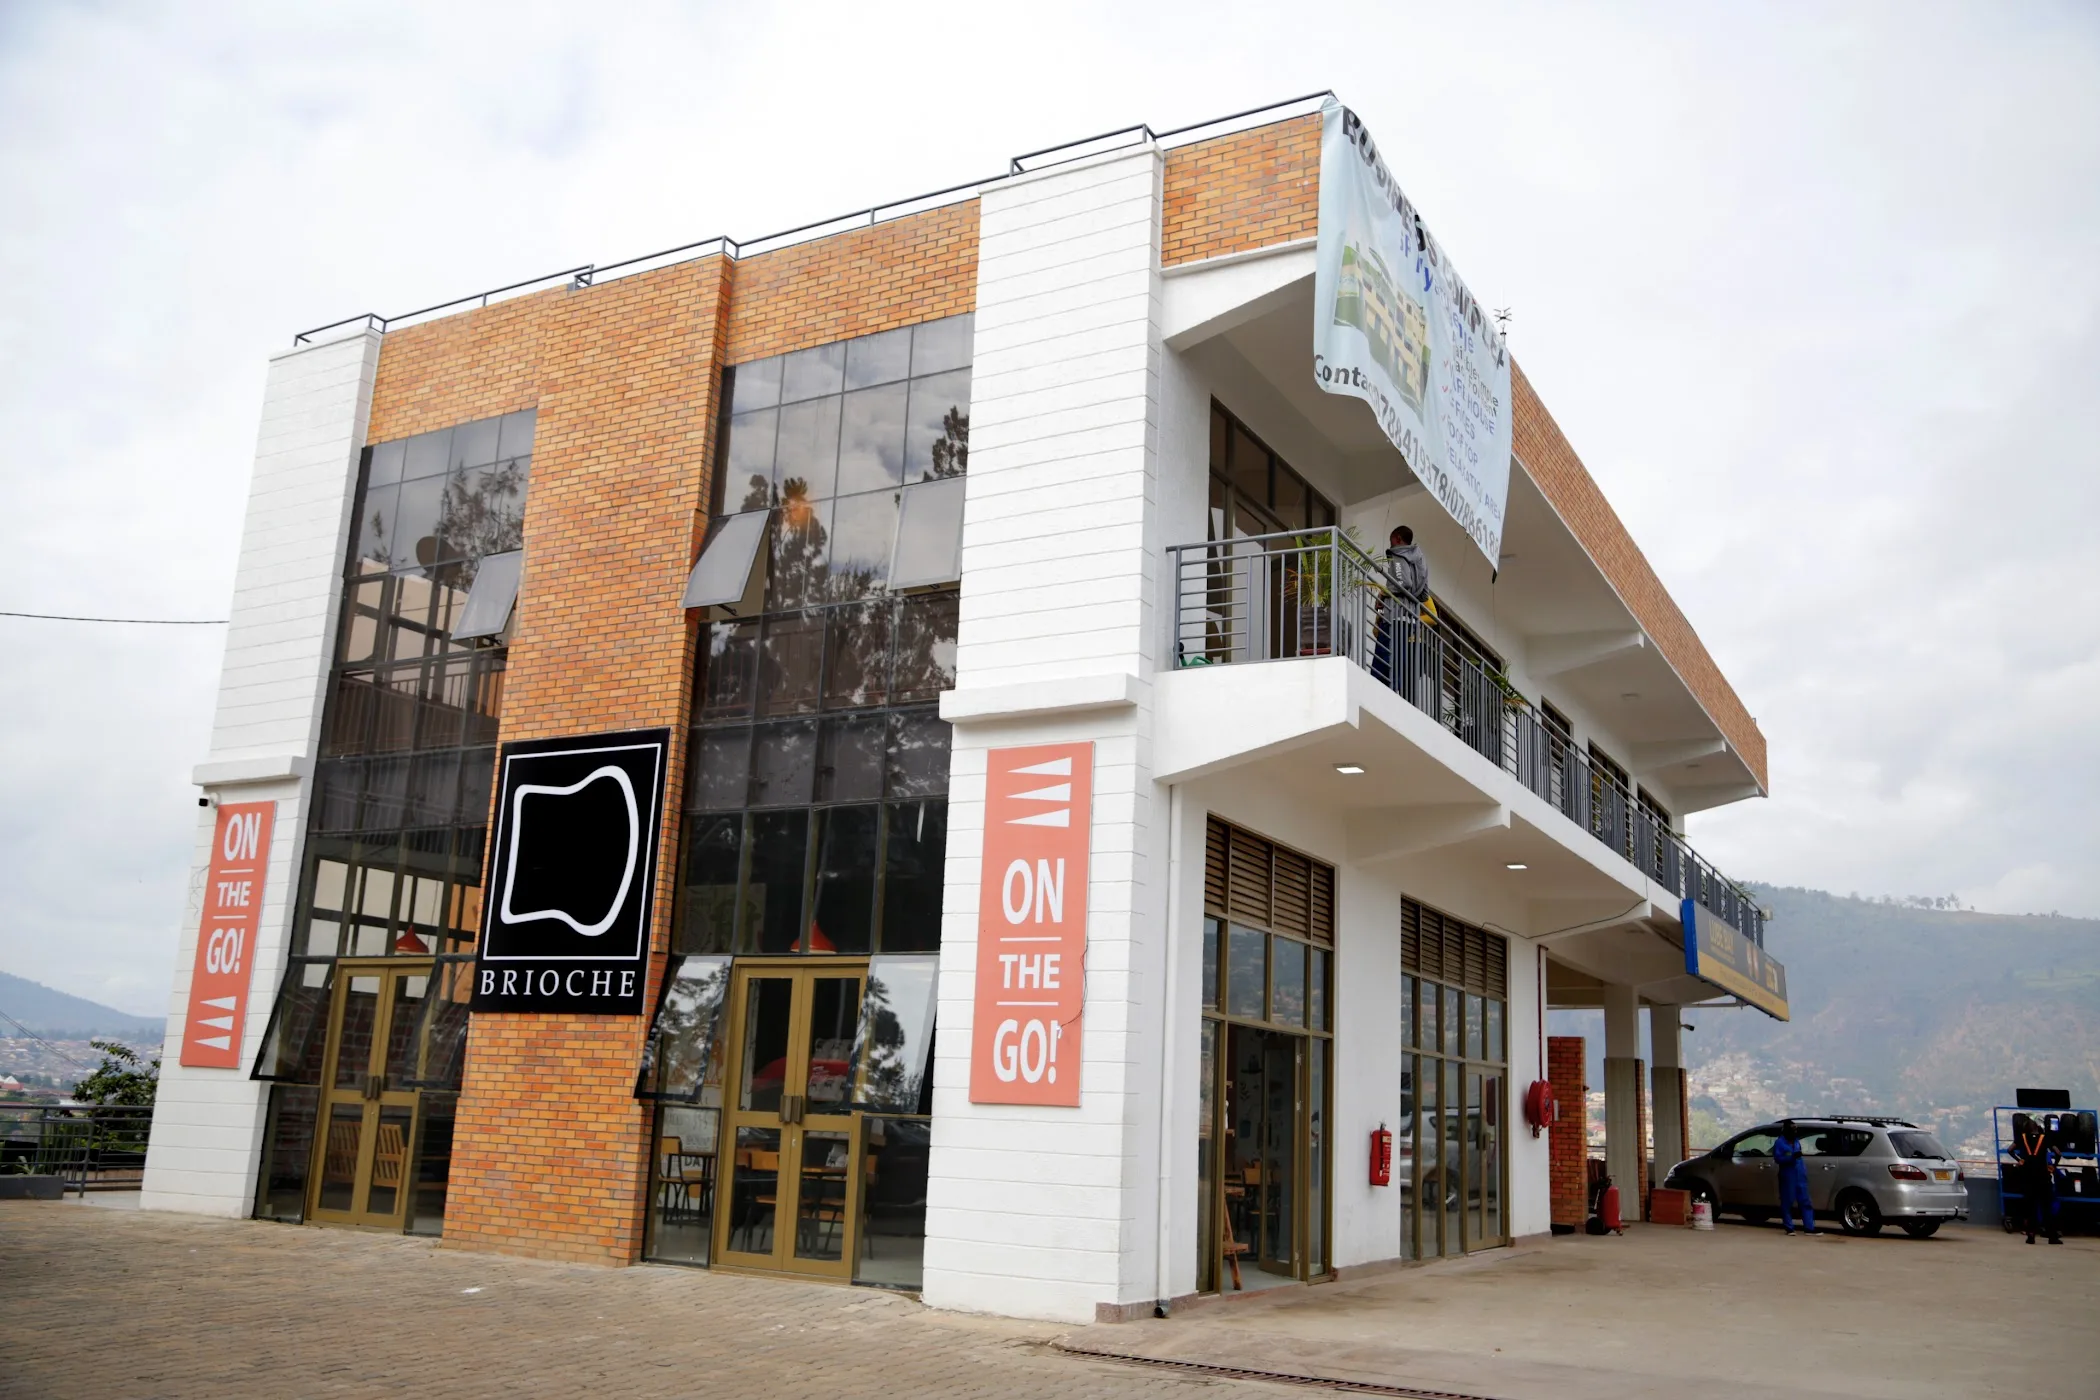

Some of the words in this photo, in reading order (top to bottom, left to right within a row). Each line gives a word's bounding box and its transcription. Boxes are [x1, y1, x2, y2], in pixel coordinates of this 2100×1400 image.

[223, 812, 262, 862] ON
[217, 880, 252, 908] THE
[1002, 857, 1065, 925] ON
[205, 927, 246, 975] GO!
[998, 953, 1061, 989] THE
[479, 969, 636, 997] BRIOCHE
[993, 1018, 1059, 1085] GO!
